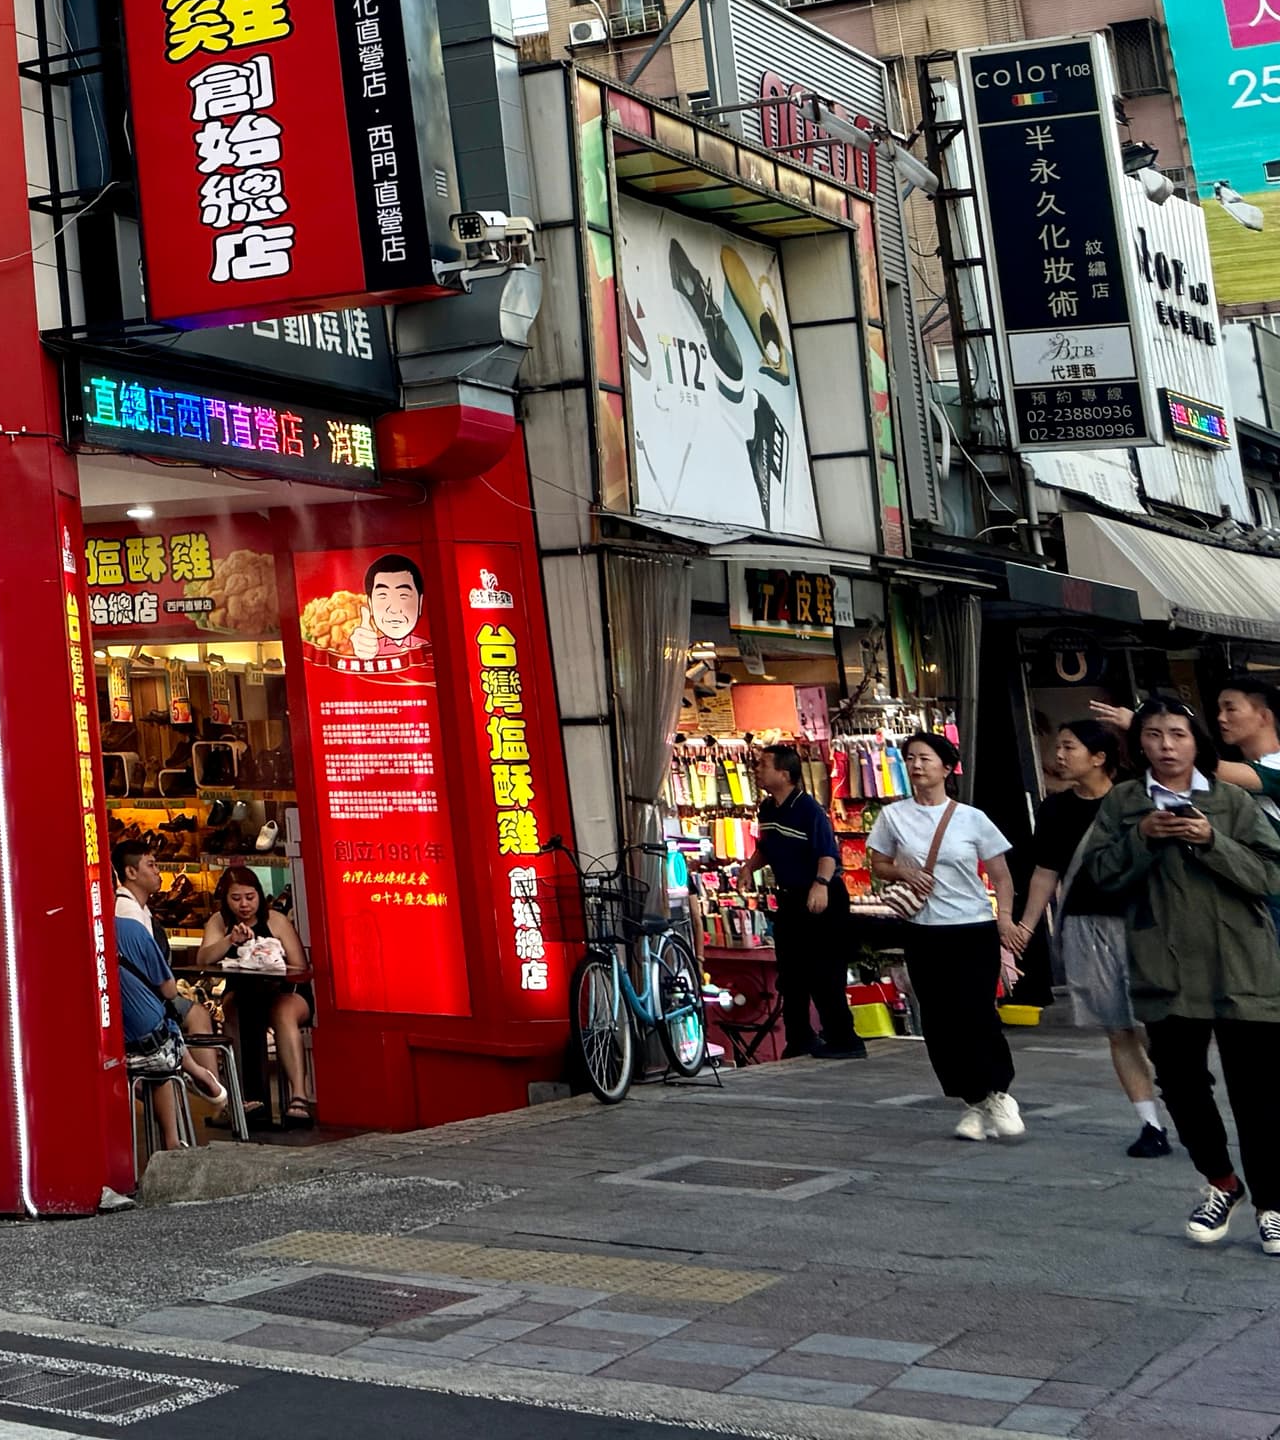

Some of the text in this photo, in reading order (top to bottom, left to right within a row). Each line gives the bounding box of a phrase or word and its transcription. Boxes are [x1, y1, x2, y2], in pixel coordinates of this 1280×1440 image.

[975, 61, 1090, 88] color 108
[190, 55, 293, 283] 創始總店
[368, 126, 407, 262] 西門直營店
[1025, 126, 1078, 318] 半永久化妝術
[1027, 406, 1132, 423] 02-23880936
[1051, 363, 1096, 378] 代理商
[1029, 424, 1135, 441] 02-23880996
[85, 533, 213, 585] 塩酥雞
[476, 622, 540, 855] 台灣塩酥雞
[508, 866, 547, 991] 創始總店
